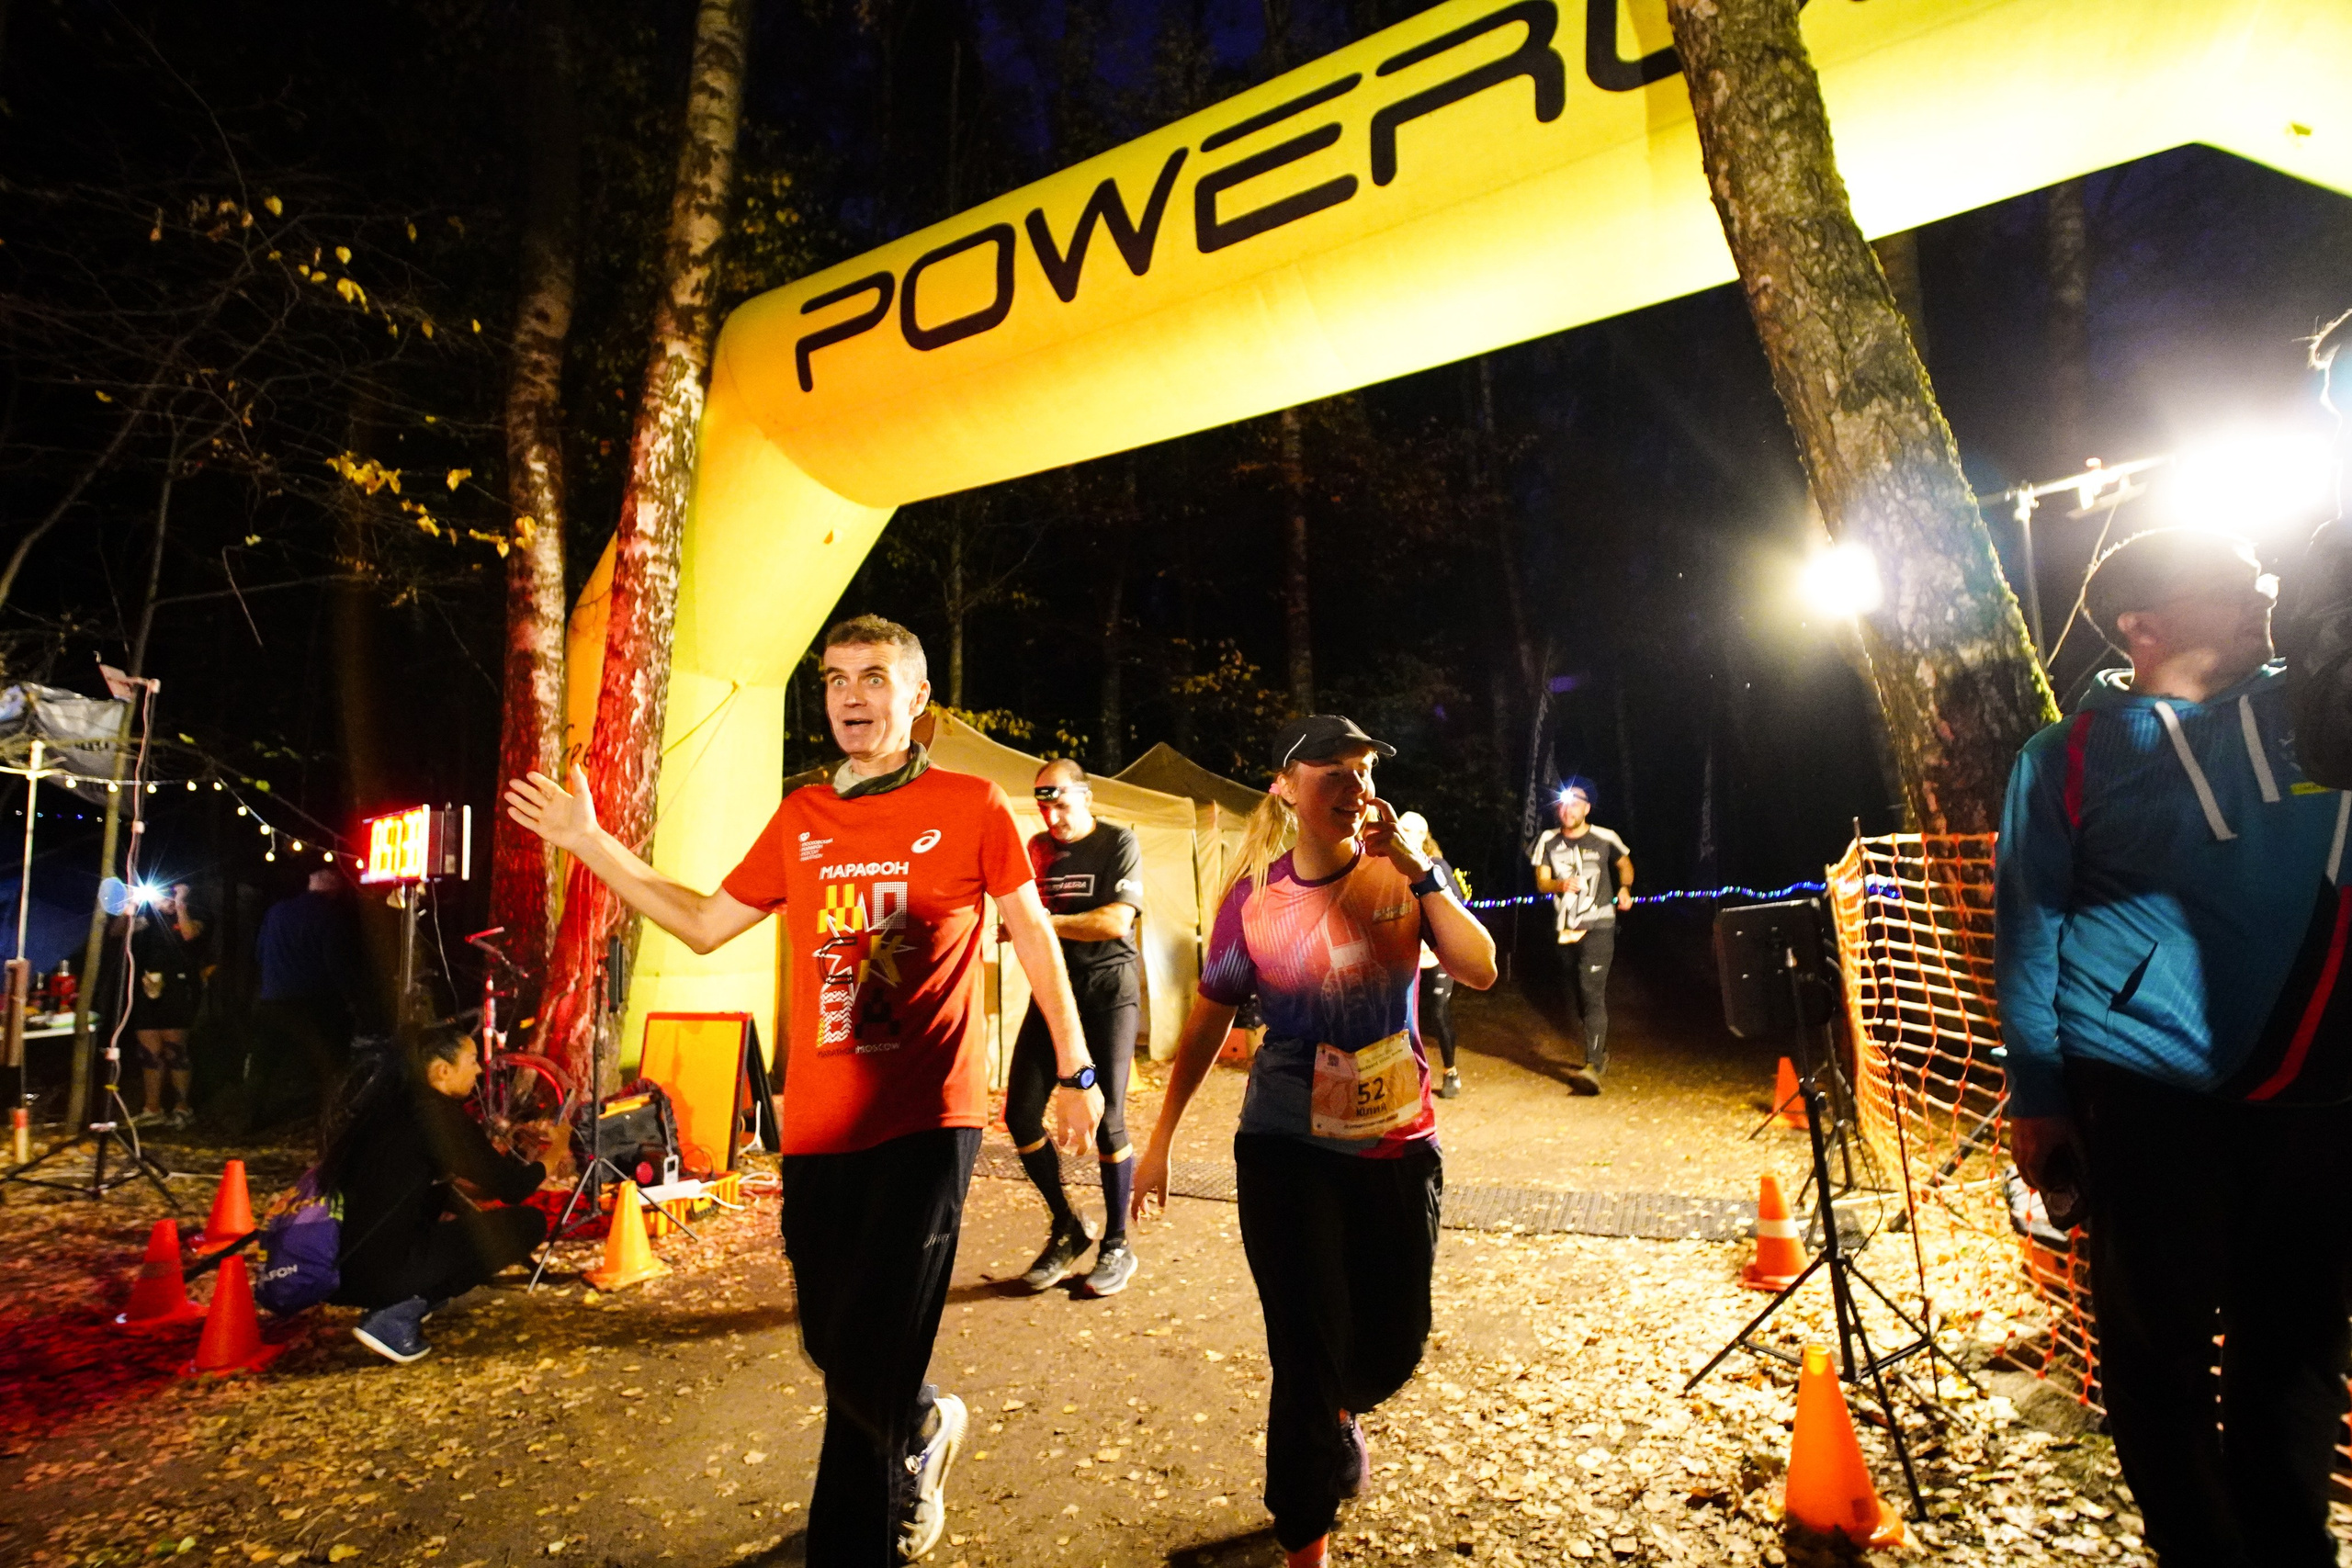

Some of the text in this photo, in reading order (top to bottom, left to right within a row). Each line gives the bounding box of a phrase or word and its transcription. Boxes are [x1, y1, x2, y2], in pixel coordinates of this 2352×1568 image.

[819, 862, 910, 880] МАРАФОН
[855, 1043, 901, 1055] MOSCOW
[1357, 1077, 1385, 1105] 52
